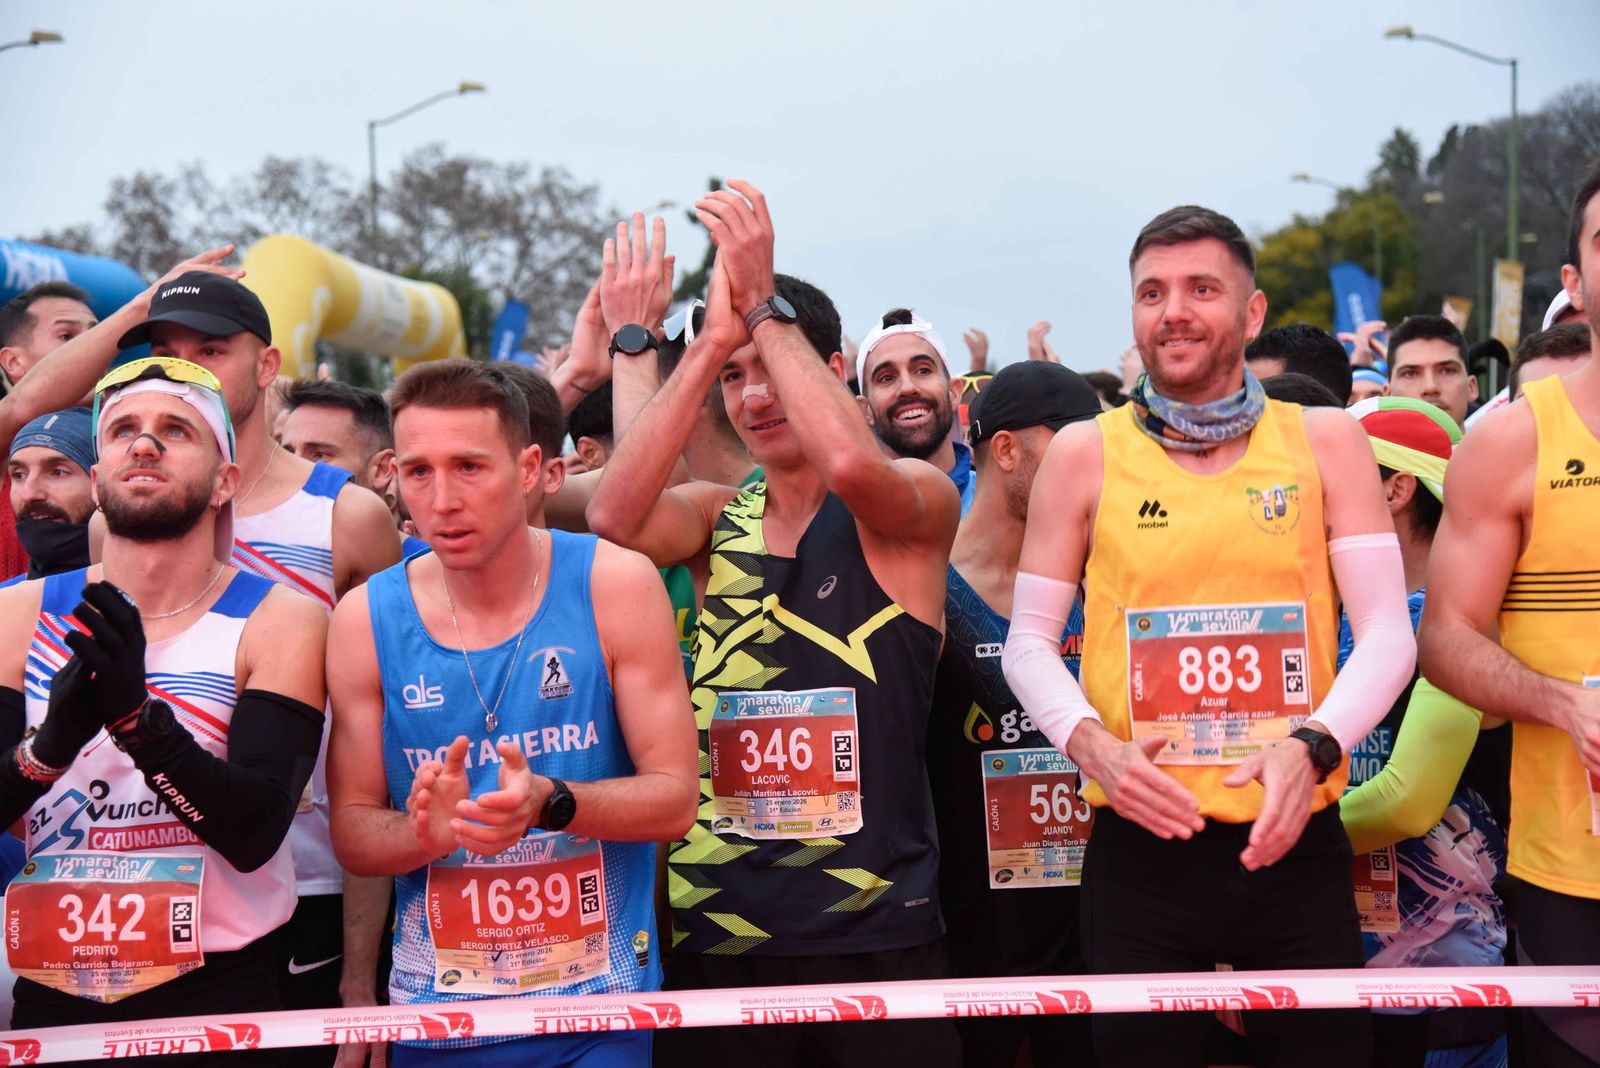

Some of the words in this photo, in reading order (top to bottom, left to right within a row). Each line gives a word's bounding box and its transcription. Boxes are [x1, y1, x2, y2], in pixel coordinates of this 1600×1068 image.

[161, 286, 201, 300] KIPRUN
[1137, 521, 1169, 530] mobel
[1186, 608, 1249, 622] maratón
[1202, 620, 1249, 632] sevilla
[1178, 644, 1262, 695] 883
[744, 695, 801, 706] maratón
[1200, 696, 1229, 708] Azuar
[758, 702, 801, 715] sevilla
[1180, 712, 1215, 721] Antonio
[1251, 710, 1276, 718] azuar
[739, 727, 813, 773] 346
[1193, 748, 1219, 757] HOKA
[1035, 753, 1069, 762] mara
[751, 774, 790, 785] LACOVIC
[152, 772, 204, 823] KIPRUN
[787, 788, 819, 796] Lacovic
[754, 823, 775, 831] HOKA
[780, 823, 809, 831] Sprinter
[1042, 825, 1073, 836] JUANDY
[1042, 839, 1062, 848] Diego
[72, 856, 140, 869] maratón
[495, 851, 543, 864] sevilla
[87, 867, 141, 879] sevilla
[1043, 871, 1064, 879] HOKA
[461, 872, 571, 925] 1639
[57, 893, 147, 943] 342
[476, 926, 514, 938] SERGIO
[516, 922, 546, 936] ORTIZ
[460, 940, 493, 951] SERGIO
[495, 939, 523, 951] ORTIZ
[524, 934, 569, 948] VELASCO
[72, 945, 119, 956] PEDRITO
[515, 950, 536, 959] enero
[43, 961, 71, 969] Pedro
[73, 961, 109, 969] Garrido
[111, 959, 154, 970] Bejarano
[492, 976, 518, 986] HOKA
[572, 1005, 600, 1013] Creativa
[323, 1017, 351, 1025] Eventos
[363, 1015, 392, 1023] Creativa
[145, 1026, 176, 1035] Creativa
[177, 1025, 202, 1034] Acción
[534, 1016, 632, 1035] CREATE
[104, 1030, 133, 1038] Eventos
[134, 1028, 144, 1036] de
[322, 1026, 422, 1046] CREATE
[102, 1038, 206, 1059] CREATE
